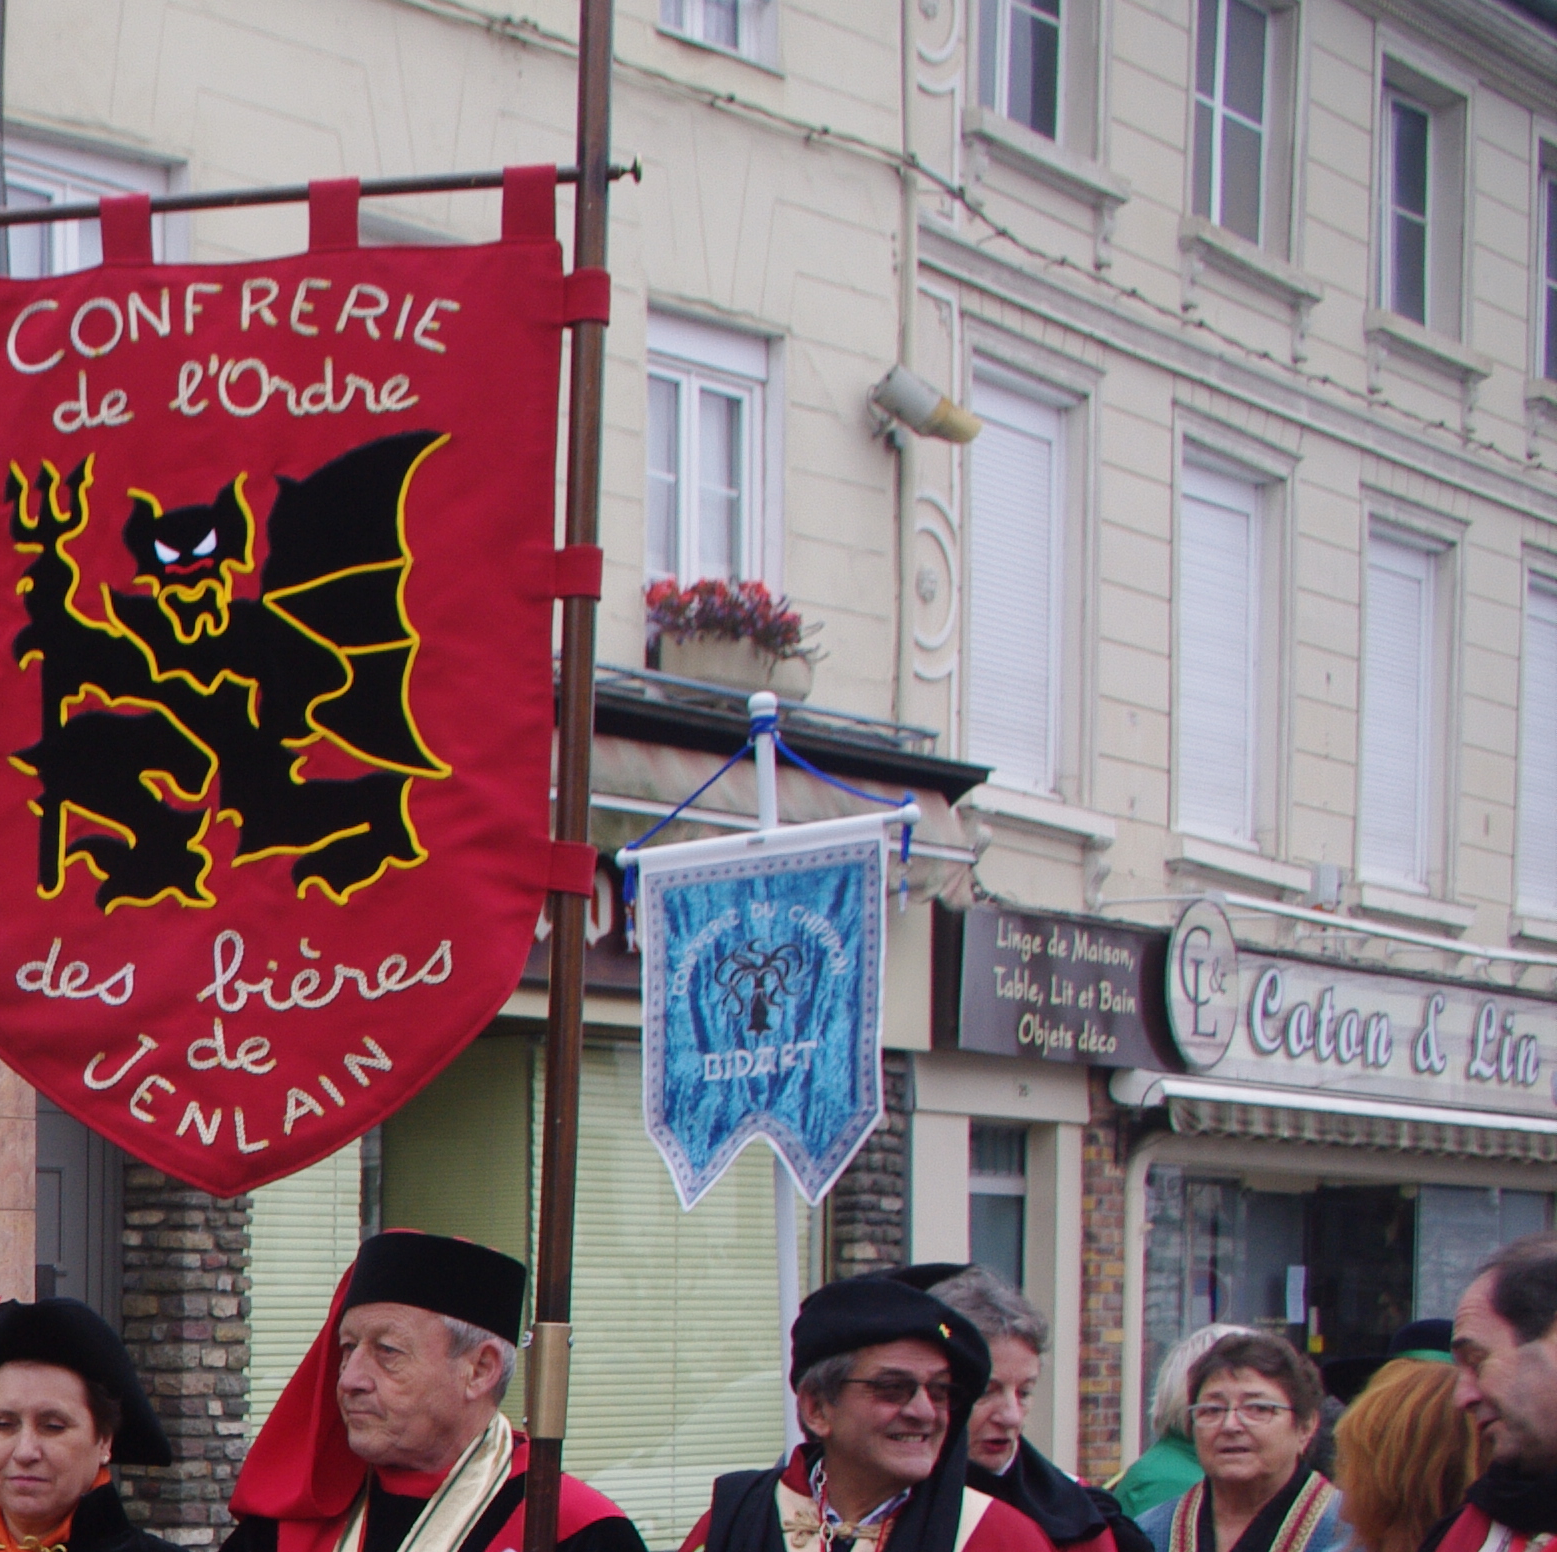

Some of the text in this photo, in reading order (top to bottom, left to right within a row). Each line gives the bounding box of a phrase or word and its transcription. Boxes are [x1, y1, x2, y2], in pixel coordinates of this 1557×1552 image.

[6, 277, 462, 375] CONFRERIE
[53, 354, 420, 433] de l'Ordre
[751, 901, 779, 920] DU
[15, 929, 454, 1013] des bières
[995, 917, 1135, 973] Linge de Maison,
[992, 965, 1136, 1015] Table, Lit et Bain
[187, 1018, 278, 1075] de
[1017, 1012, 1118, 1058] Objets déco
[1248, 966, 1541, 1088] Coton & Lin
[83, 1034, 395, 1155] JENLAIN
